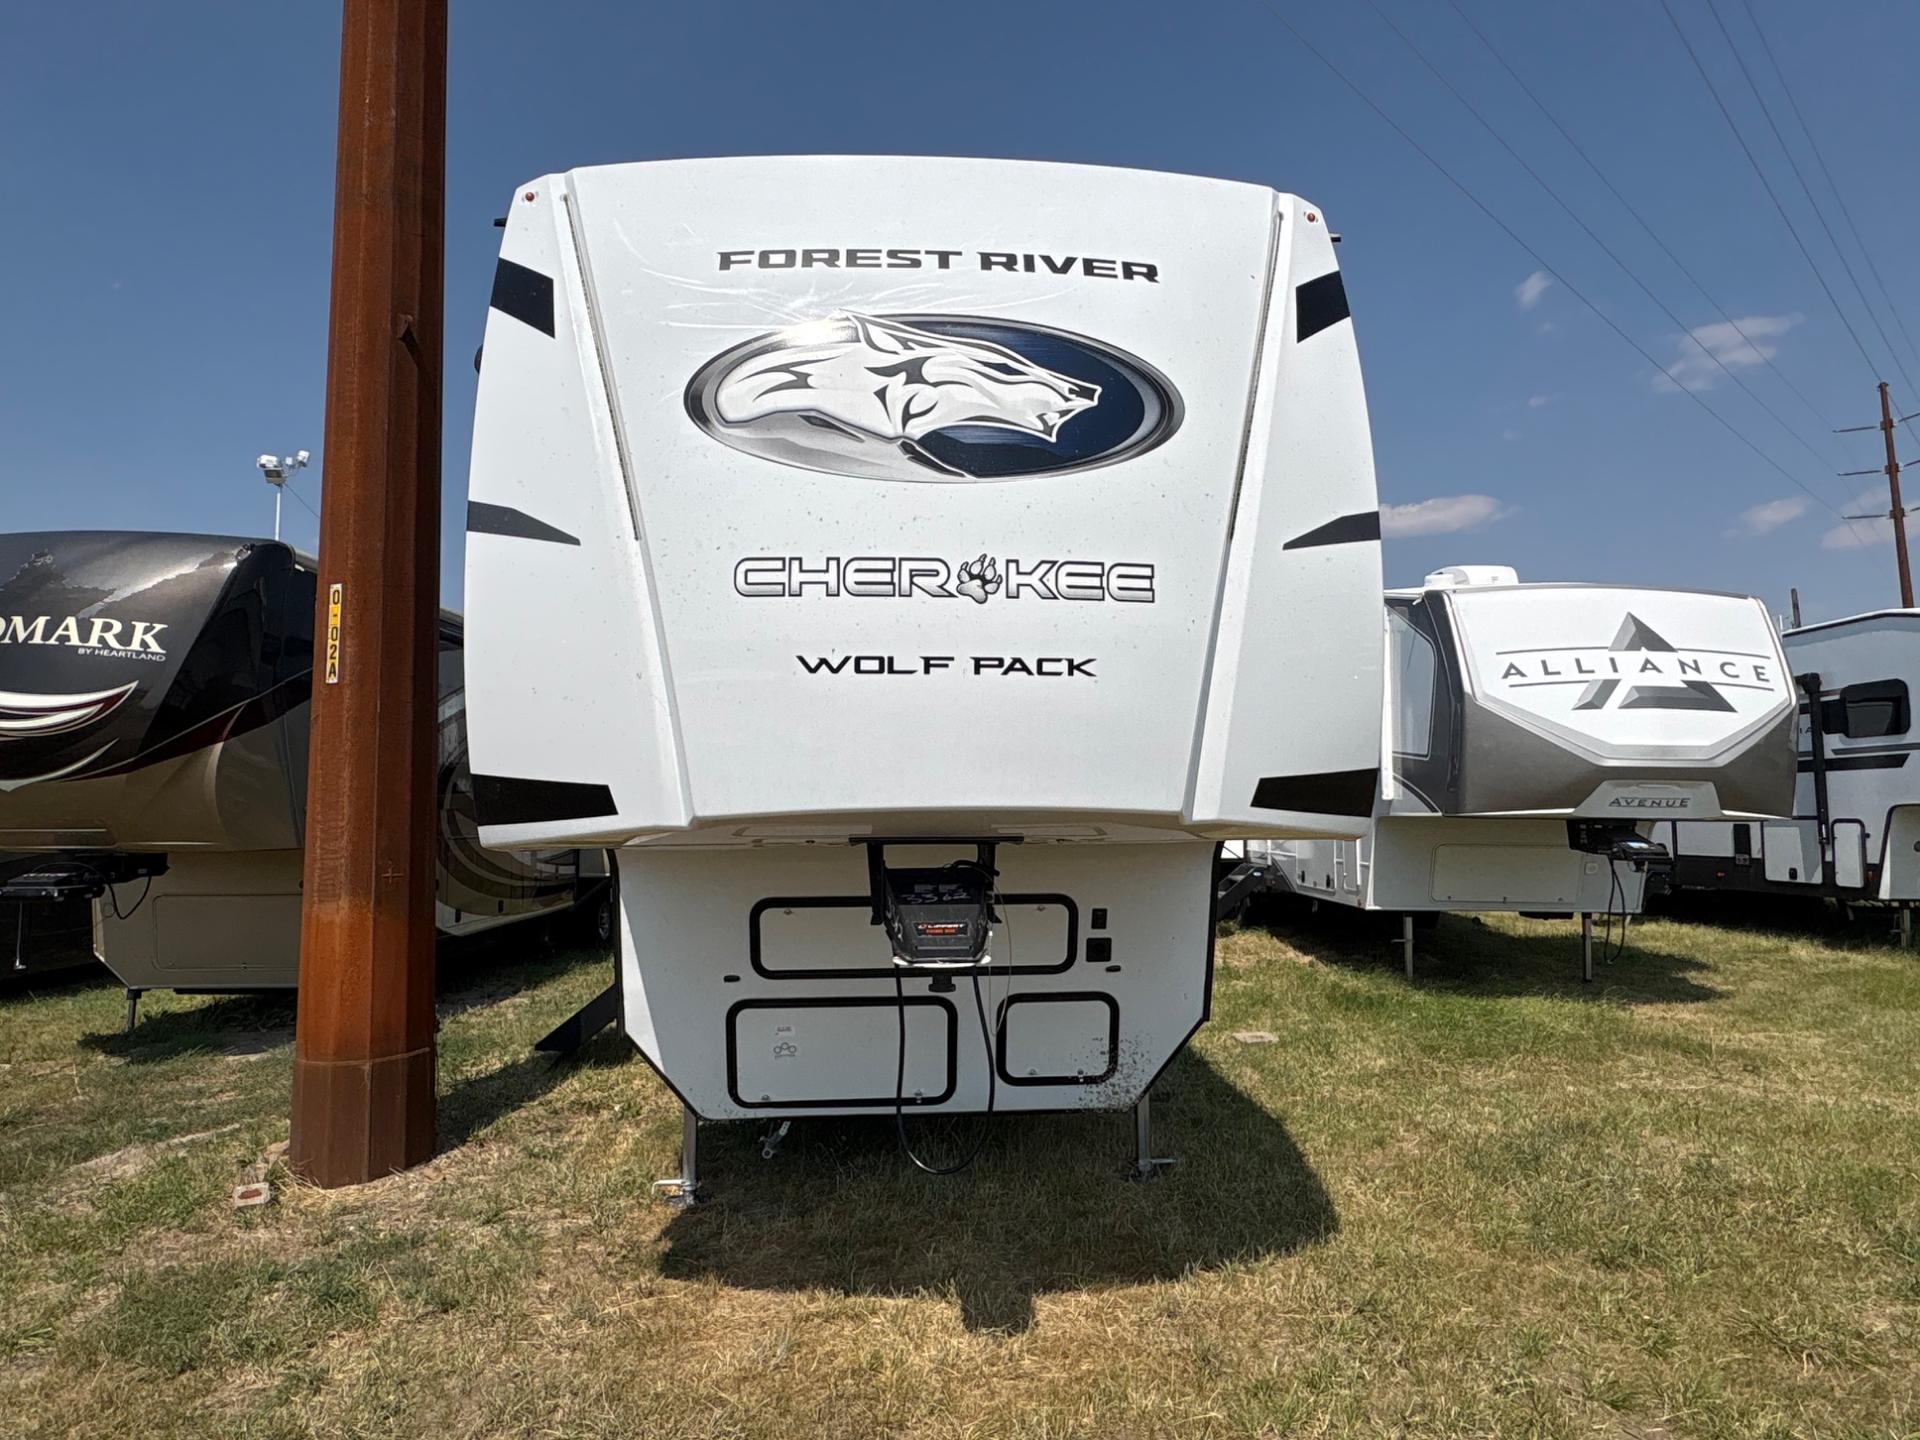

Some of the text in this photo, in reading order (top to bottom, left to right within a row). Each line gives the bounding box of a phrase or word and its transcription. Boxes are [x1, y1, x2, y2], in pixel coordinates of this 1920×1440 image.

[718, 248, 1160, 283] FOREST RIVER
[0, 616, 168, 654] MARK
[95, 649, 165, 662] HEARTLAND
[796, 655, 1098, 677] WOLF PACK
[1502, 656, 1770, 682] ALLIANCE
[1608, 797, 1691, 808] AVENUE
